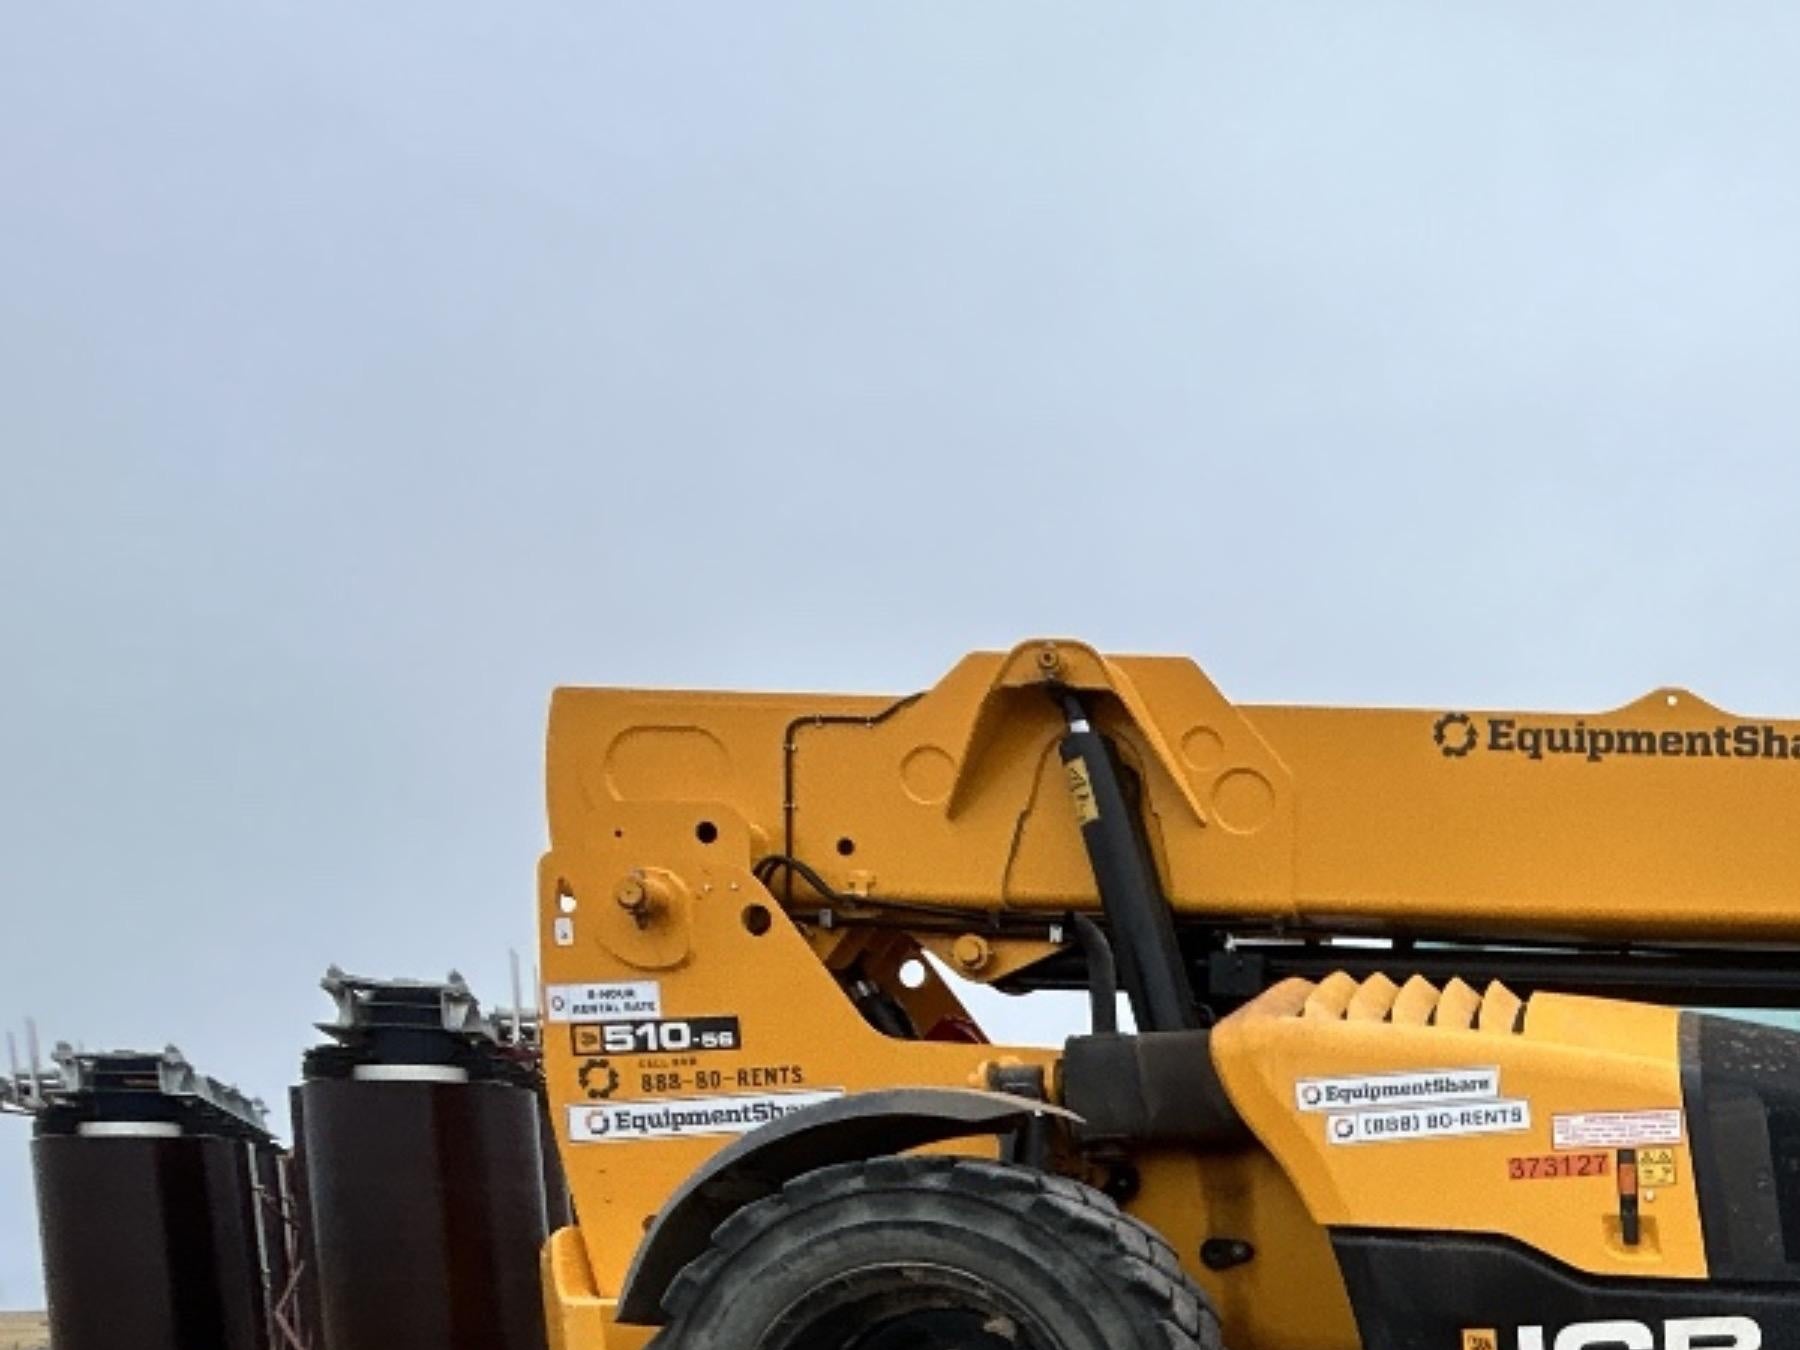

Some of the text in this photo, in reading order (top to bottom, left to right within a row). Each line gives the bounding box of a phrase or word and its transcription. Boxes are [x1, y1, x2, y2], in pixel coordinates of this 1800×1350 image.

[641, 1066, 802, 1092] 888-80-RENTS
[1325, 1077, 1493, 1104] EquipmentShare
[615, 1102, 803, 1134] EquipmentSh
[1364, 1108, 1523, 1136] (888) 80-RENTS
[1509, 1154, 1610, 1179] 373127
